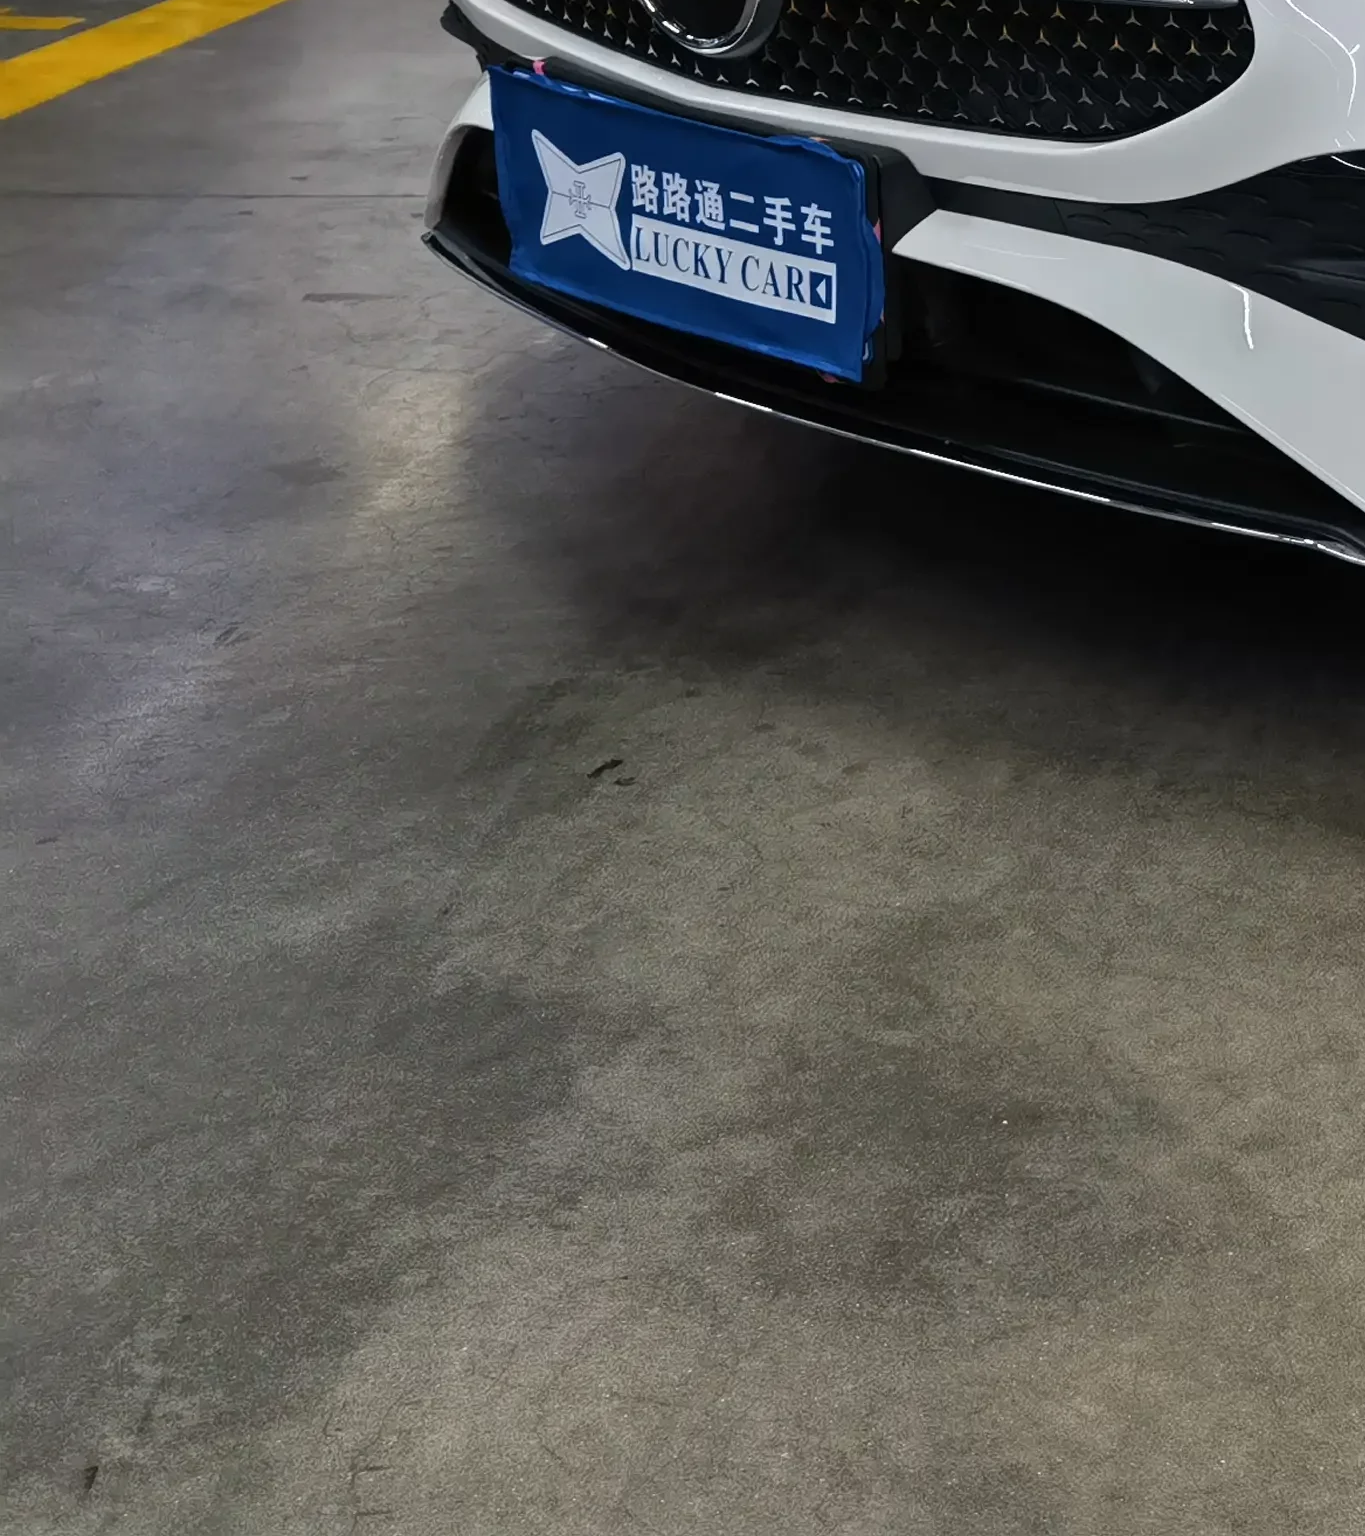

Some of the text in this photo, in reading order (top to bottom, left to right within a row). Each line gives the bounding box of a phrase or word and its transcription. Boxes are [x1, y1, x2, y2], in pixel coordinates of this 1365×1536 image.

[630, 163, 835, 255] 路路通二手车
[633, 225, 806, 306] LUCKY CAR
